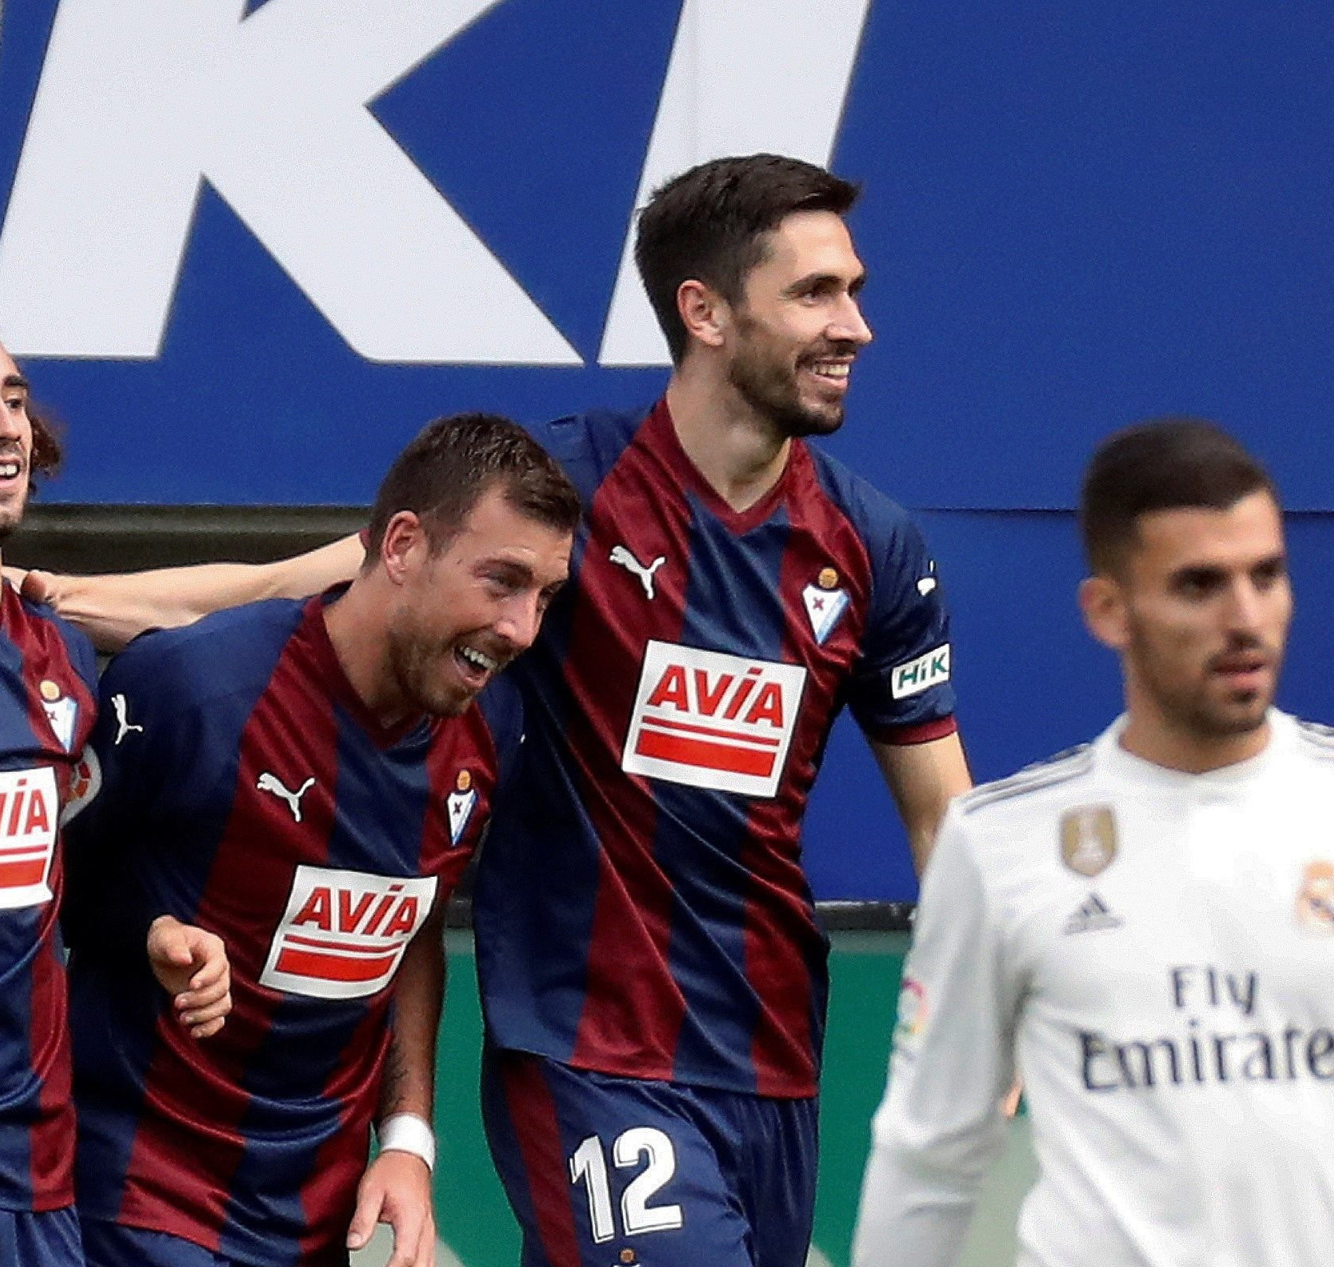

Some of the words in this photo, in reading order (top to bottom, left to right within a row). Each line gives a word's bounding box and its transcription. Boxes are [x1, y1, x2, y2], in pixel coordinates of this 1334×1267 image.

[650, 664, 784, 728] AVÍA
[295, 884, 418, 937] AVÍA
[1170, 966, 1259, 1017] Fly
[569, 1127, 683, 1245] 12
